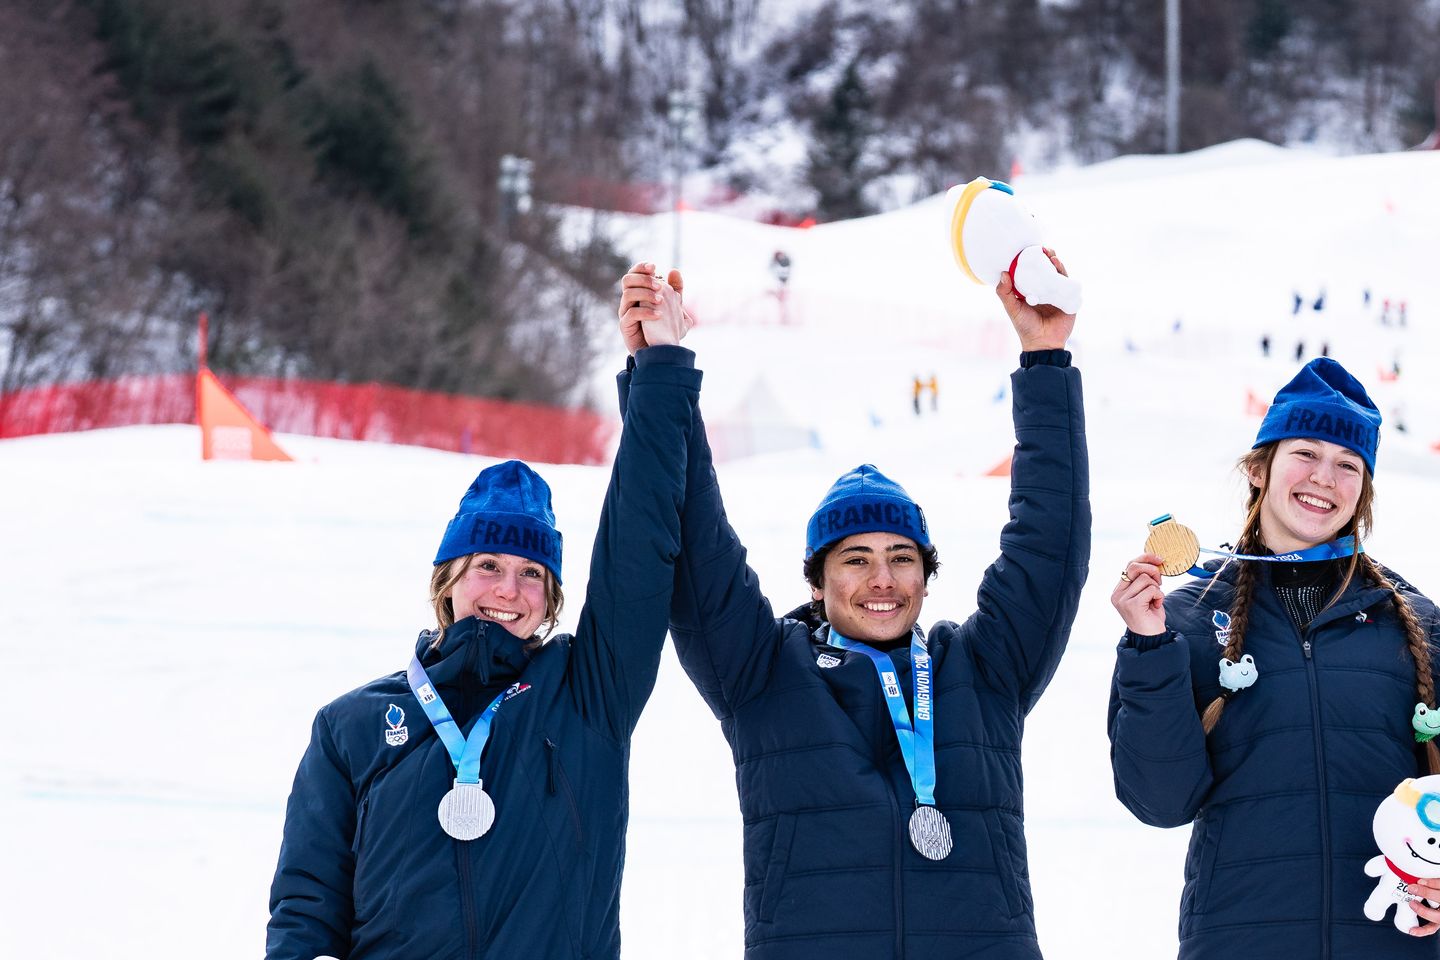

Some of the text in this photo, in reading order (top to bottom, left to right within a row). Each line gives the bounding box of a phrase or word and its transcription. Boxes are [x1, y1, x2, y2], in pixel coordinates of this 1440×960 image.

[1285, 406, 1373, 452] FRANCE
[817, 502, 914, 540] FRANCE
[820, 654, 839, 663] FRANCE
[917, 670, 931, 720] GANGWON
[386, 727, 407, 737] FRANCE
